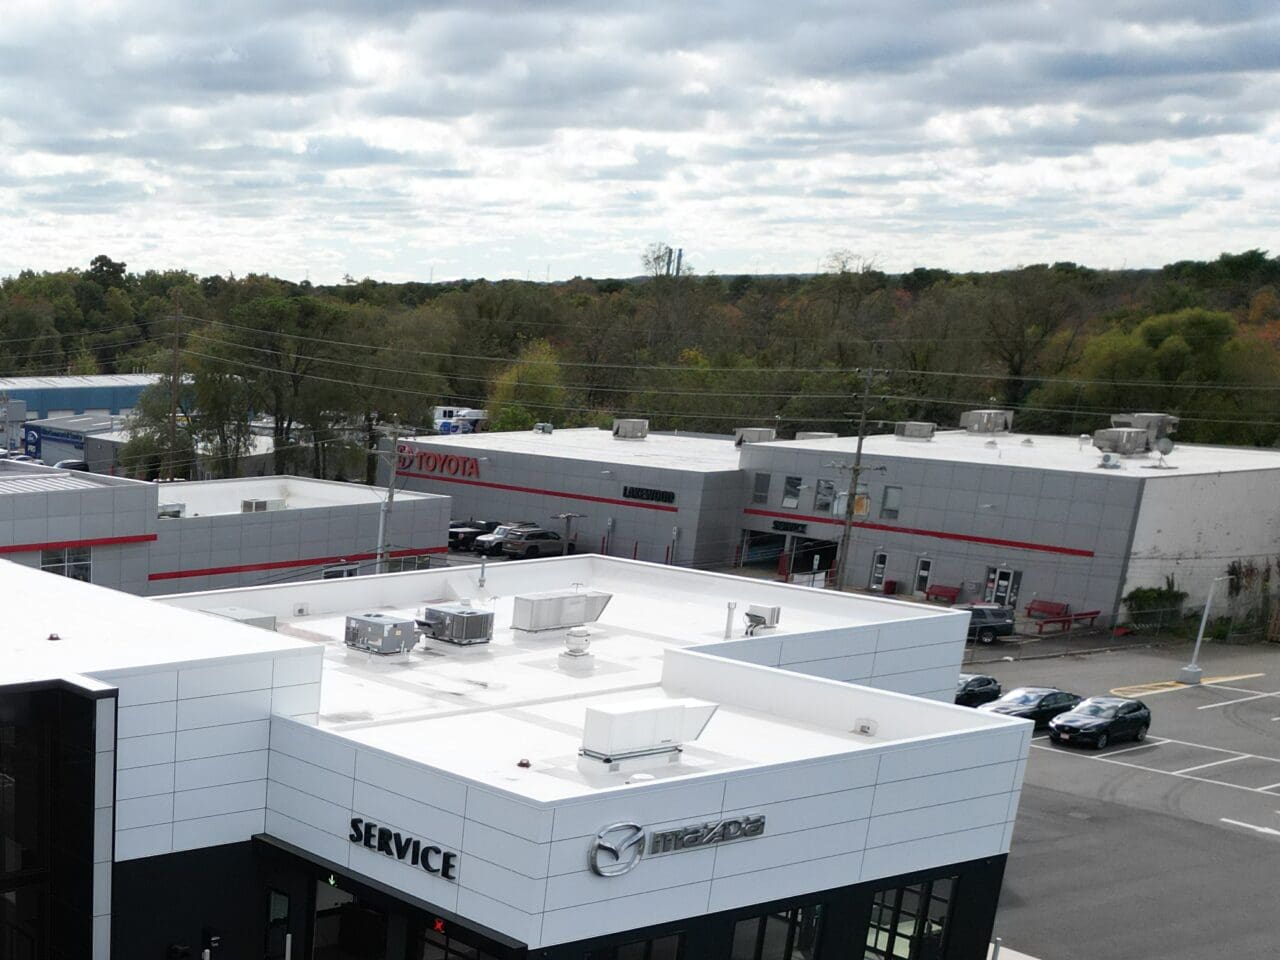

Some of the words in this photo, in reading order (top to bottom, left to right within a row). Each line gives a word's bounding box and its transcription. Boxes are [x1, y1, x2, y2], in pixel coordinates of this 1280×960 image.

[416, 451, 480, 478] TOYOTA
[349, 817, 458, 880] SERVICE
[648, 815, 766, 854] mazda
